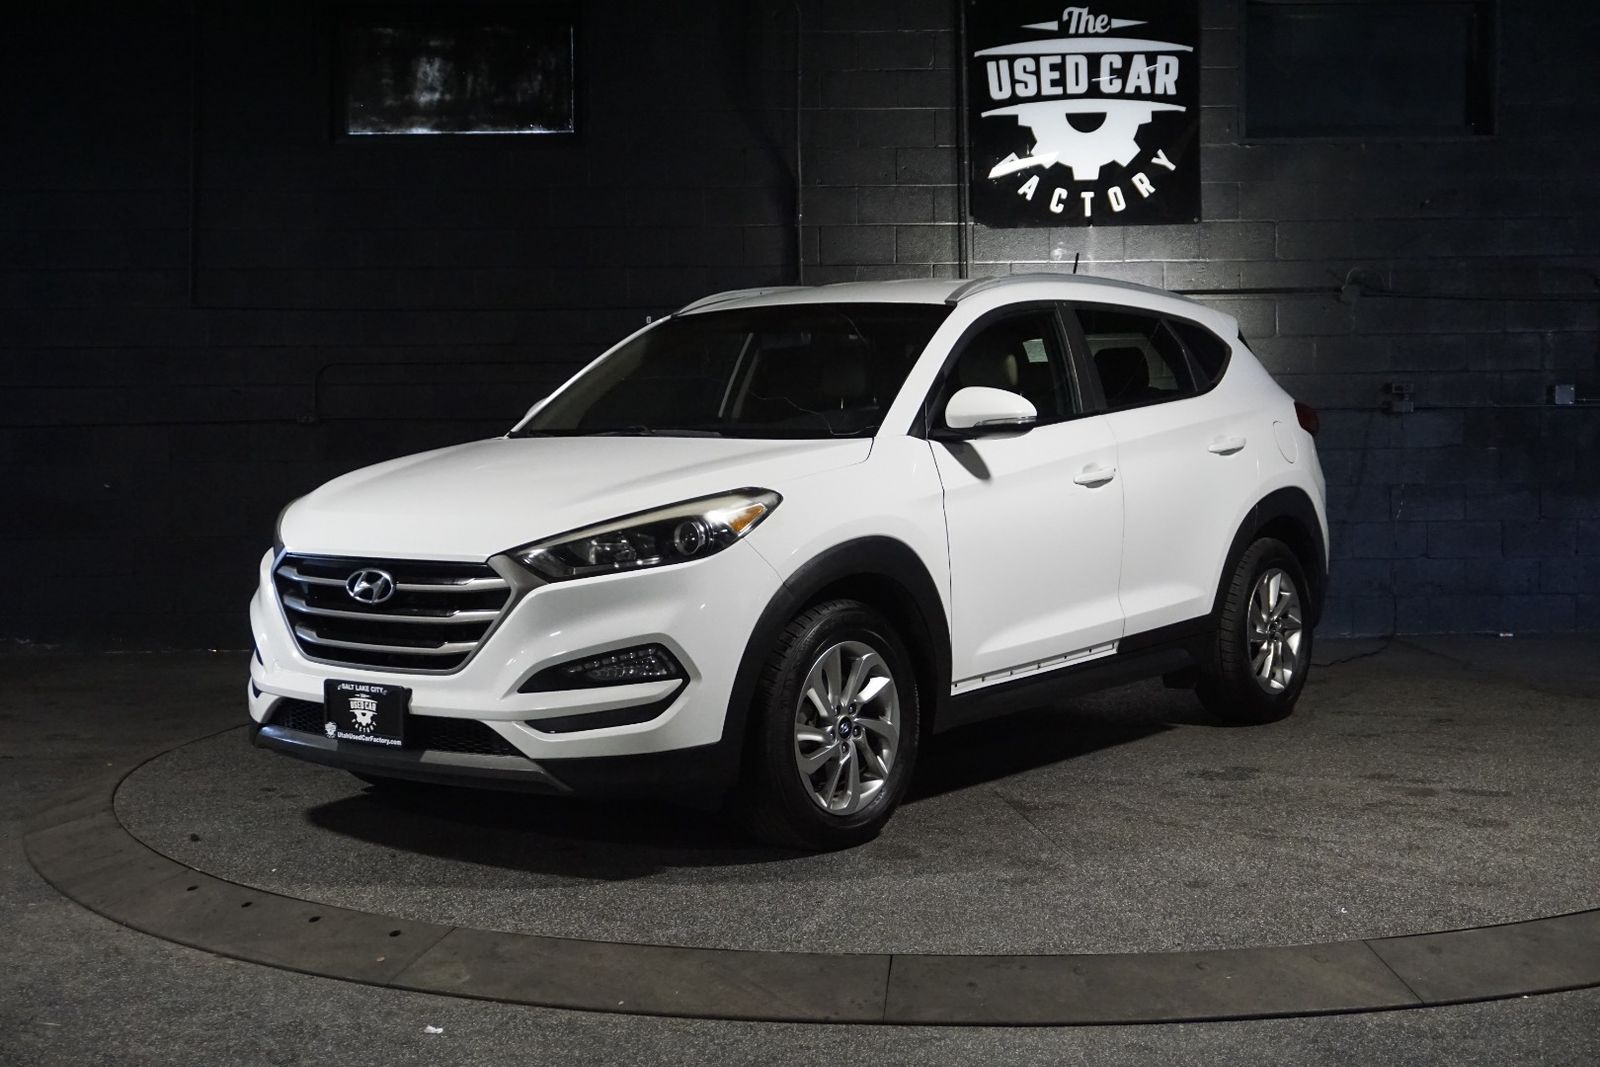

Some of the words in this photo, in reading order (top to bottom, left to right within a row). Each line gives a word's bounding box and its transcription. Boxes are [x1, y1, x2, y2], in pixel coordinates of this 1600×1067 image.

[1062, 6, 1111, 34] The
[986, 54, 1089, 100] USED
[1100, 53, 1180, 96] CAR
[341, 683, 354, 691] SALT
[355, 684, 370, 692] LAKE
[370, 686, 384, 694] CITY
